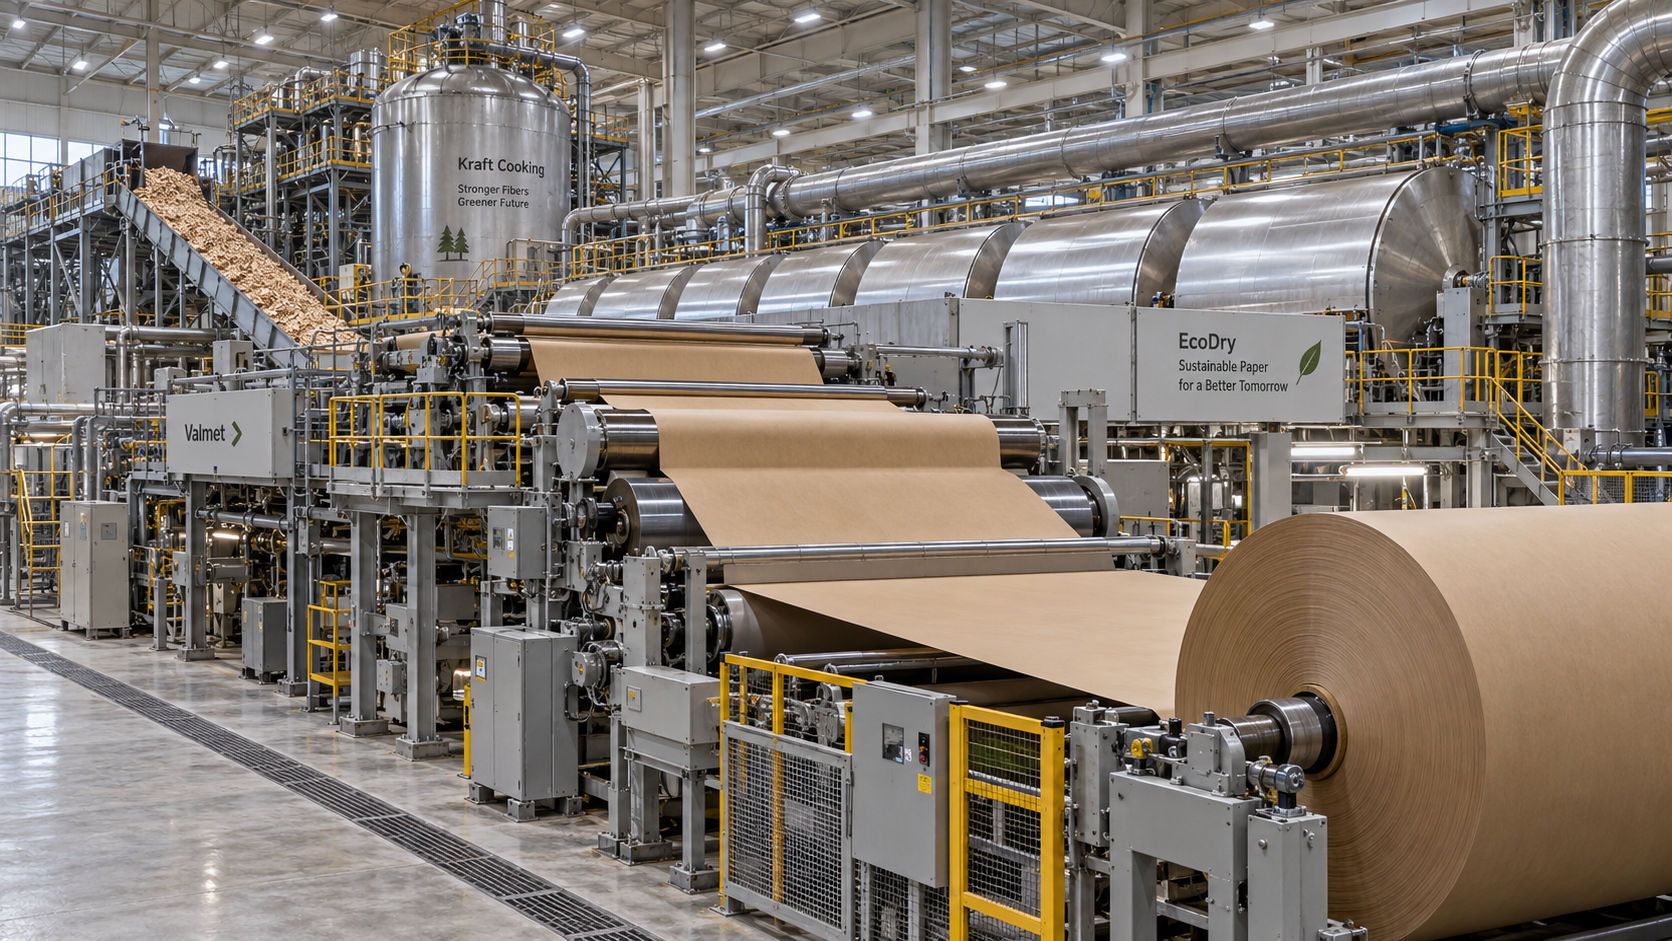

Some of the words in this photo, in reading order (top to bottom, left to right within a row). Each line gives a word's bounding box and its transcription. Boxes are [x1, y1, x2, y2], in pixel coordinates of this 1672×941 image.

[458, 157, 494, 171] Kraft
[498, 159, 545, 178] Cooking
[458, 184, 500, 196] Stronger
[502, 186, 530, 196] Fibers
[458, 197, 498, 207] Greener
[500, 198, 530, 208] Future
[1179, 332, 1236, 354] EcoDry
[1179, 359, 1238, 372] Sustainable
[1240, 360, 1269, 375] Paper
[1179, 378, 1194, 391] for
[1196, 381, 1203, 392] a
[1205, 378, 1237, 392] Better
[1239, 379, 1289, 392] Tomorrow
[184, 424, 225, 441] Valmet
